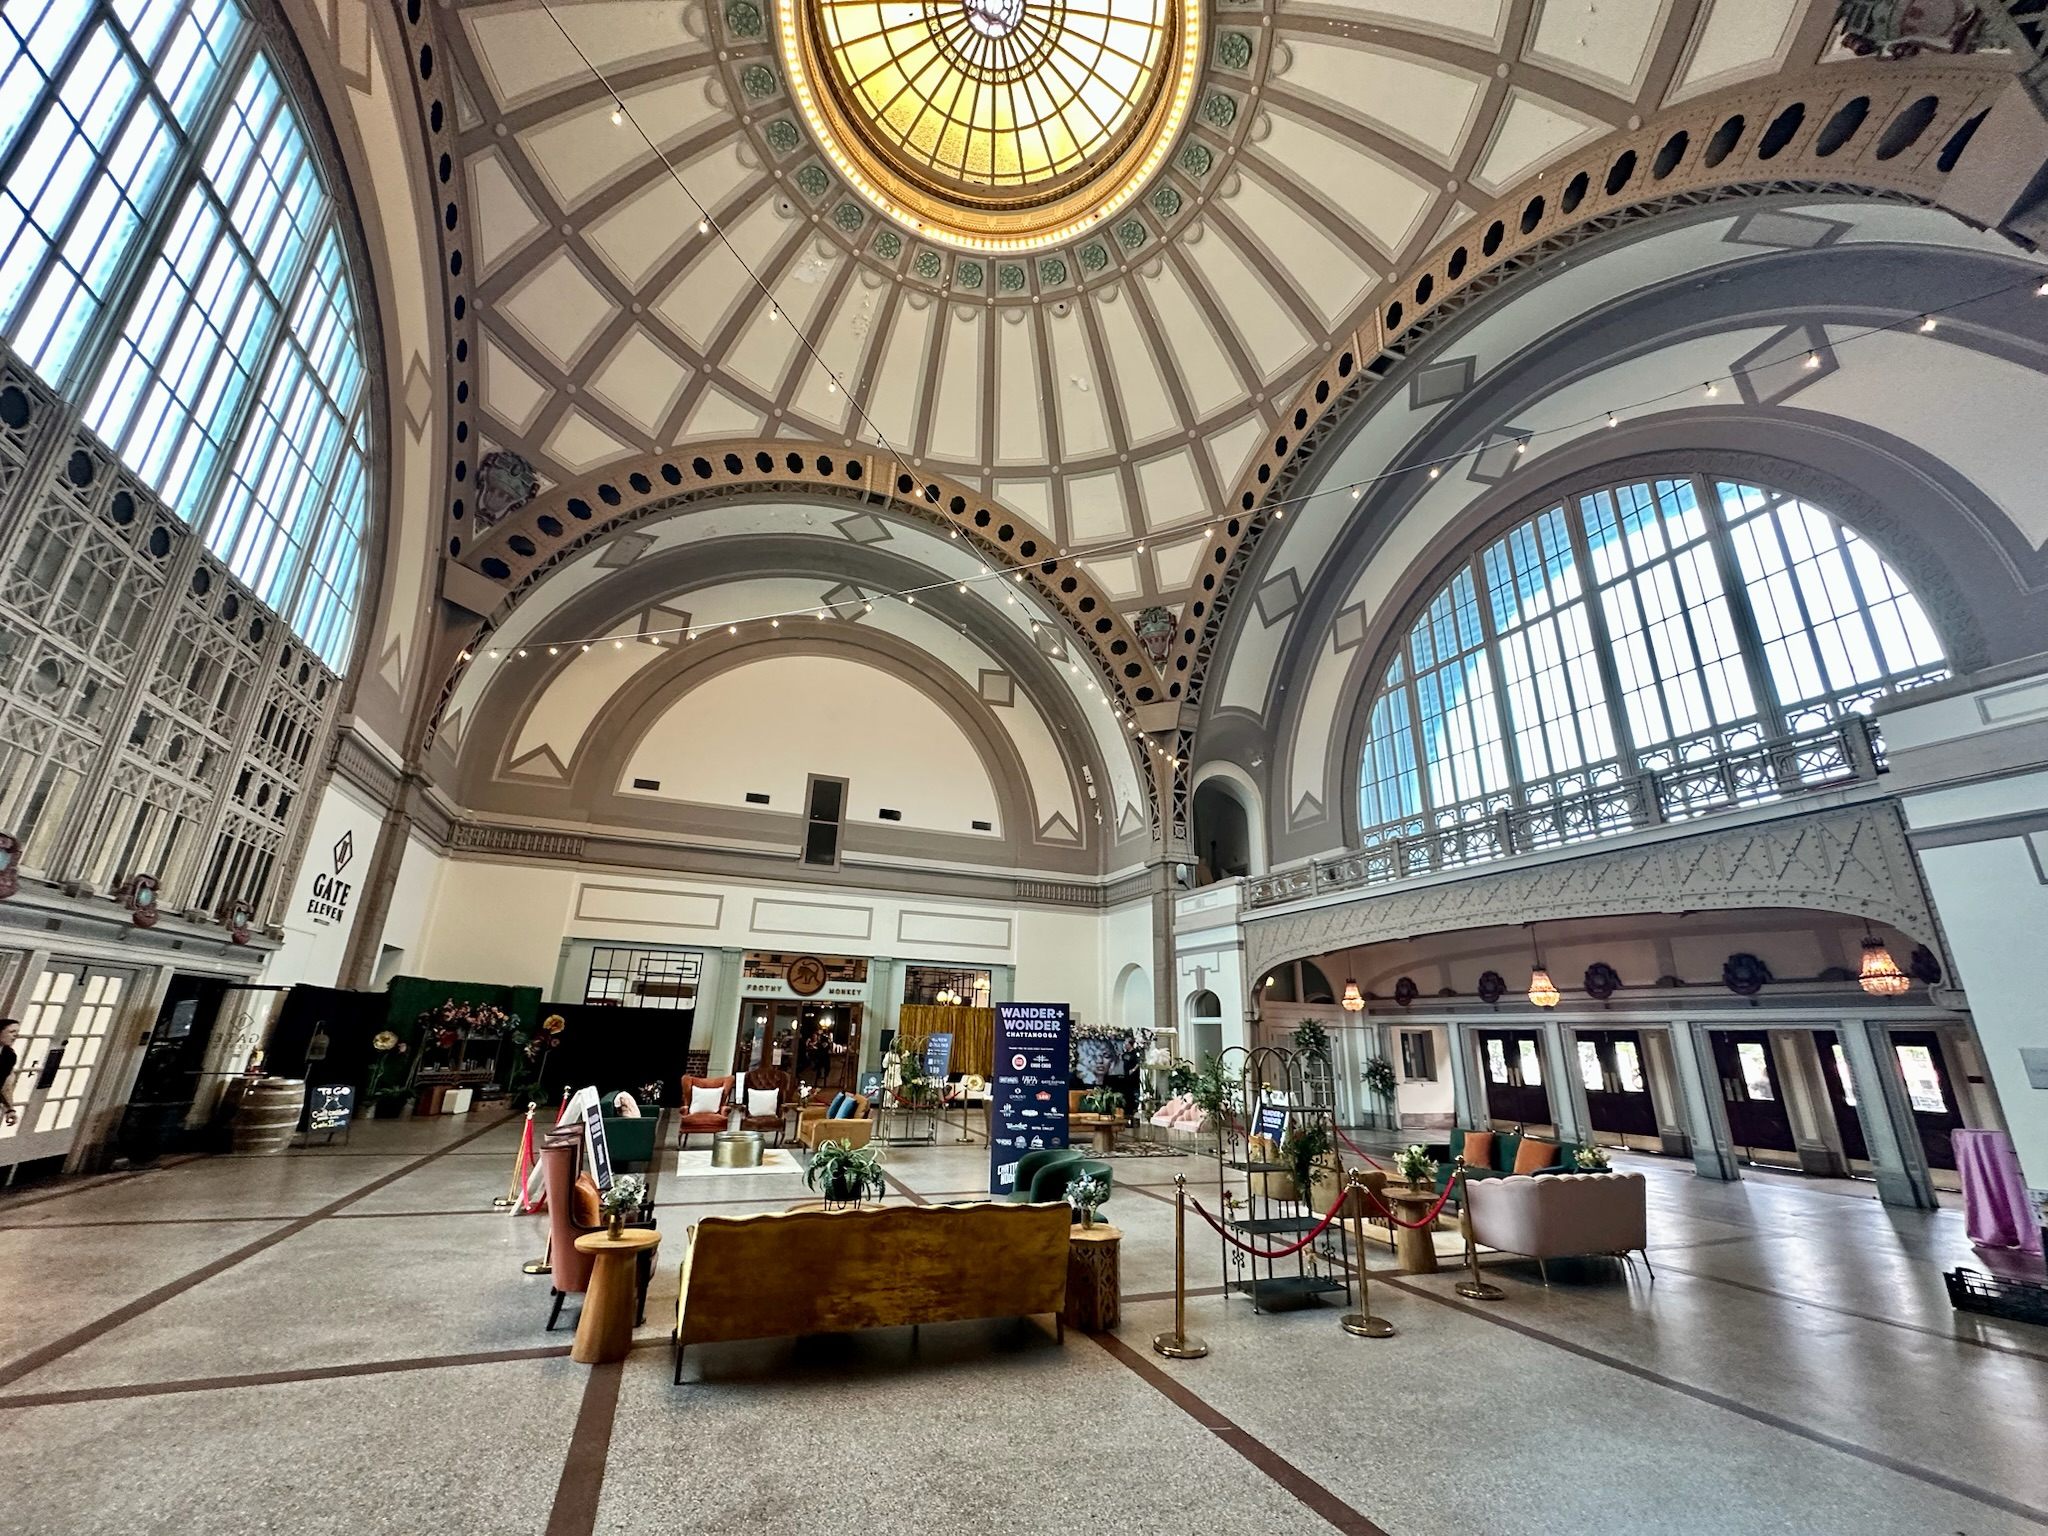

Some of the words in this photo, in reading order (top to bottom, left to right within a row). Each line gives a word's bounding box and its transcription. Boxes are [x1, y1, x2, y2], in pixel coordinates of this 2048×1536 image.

[313, 873, 352, 906] GATE
[307, 899, 344, 923] ELEVEN
[746, 984, 782, 992] FROTHY
[829, 988, 862, 996] MONKEY
[1001, 1007, 1064, 1019] WANDER+
[1003, 1019, 1061, 1031] WONDER
